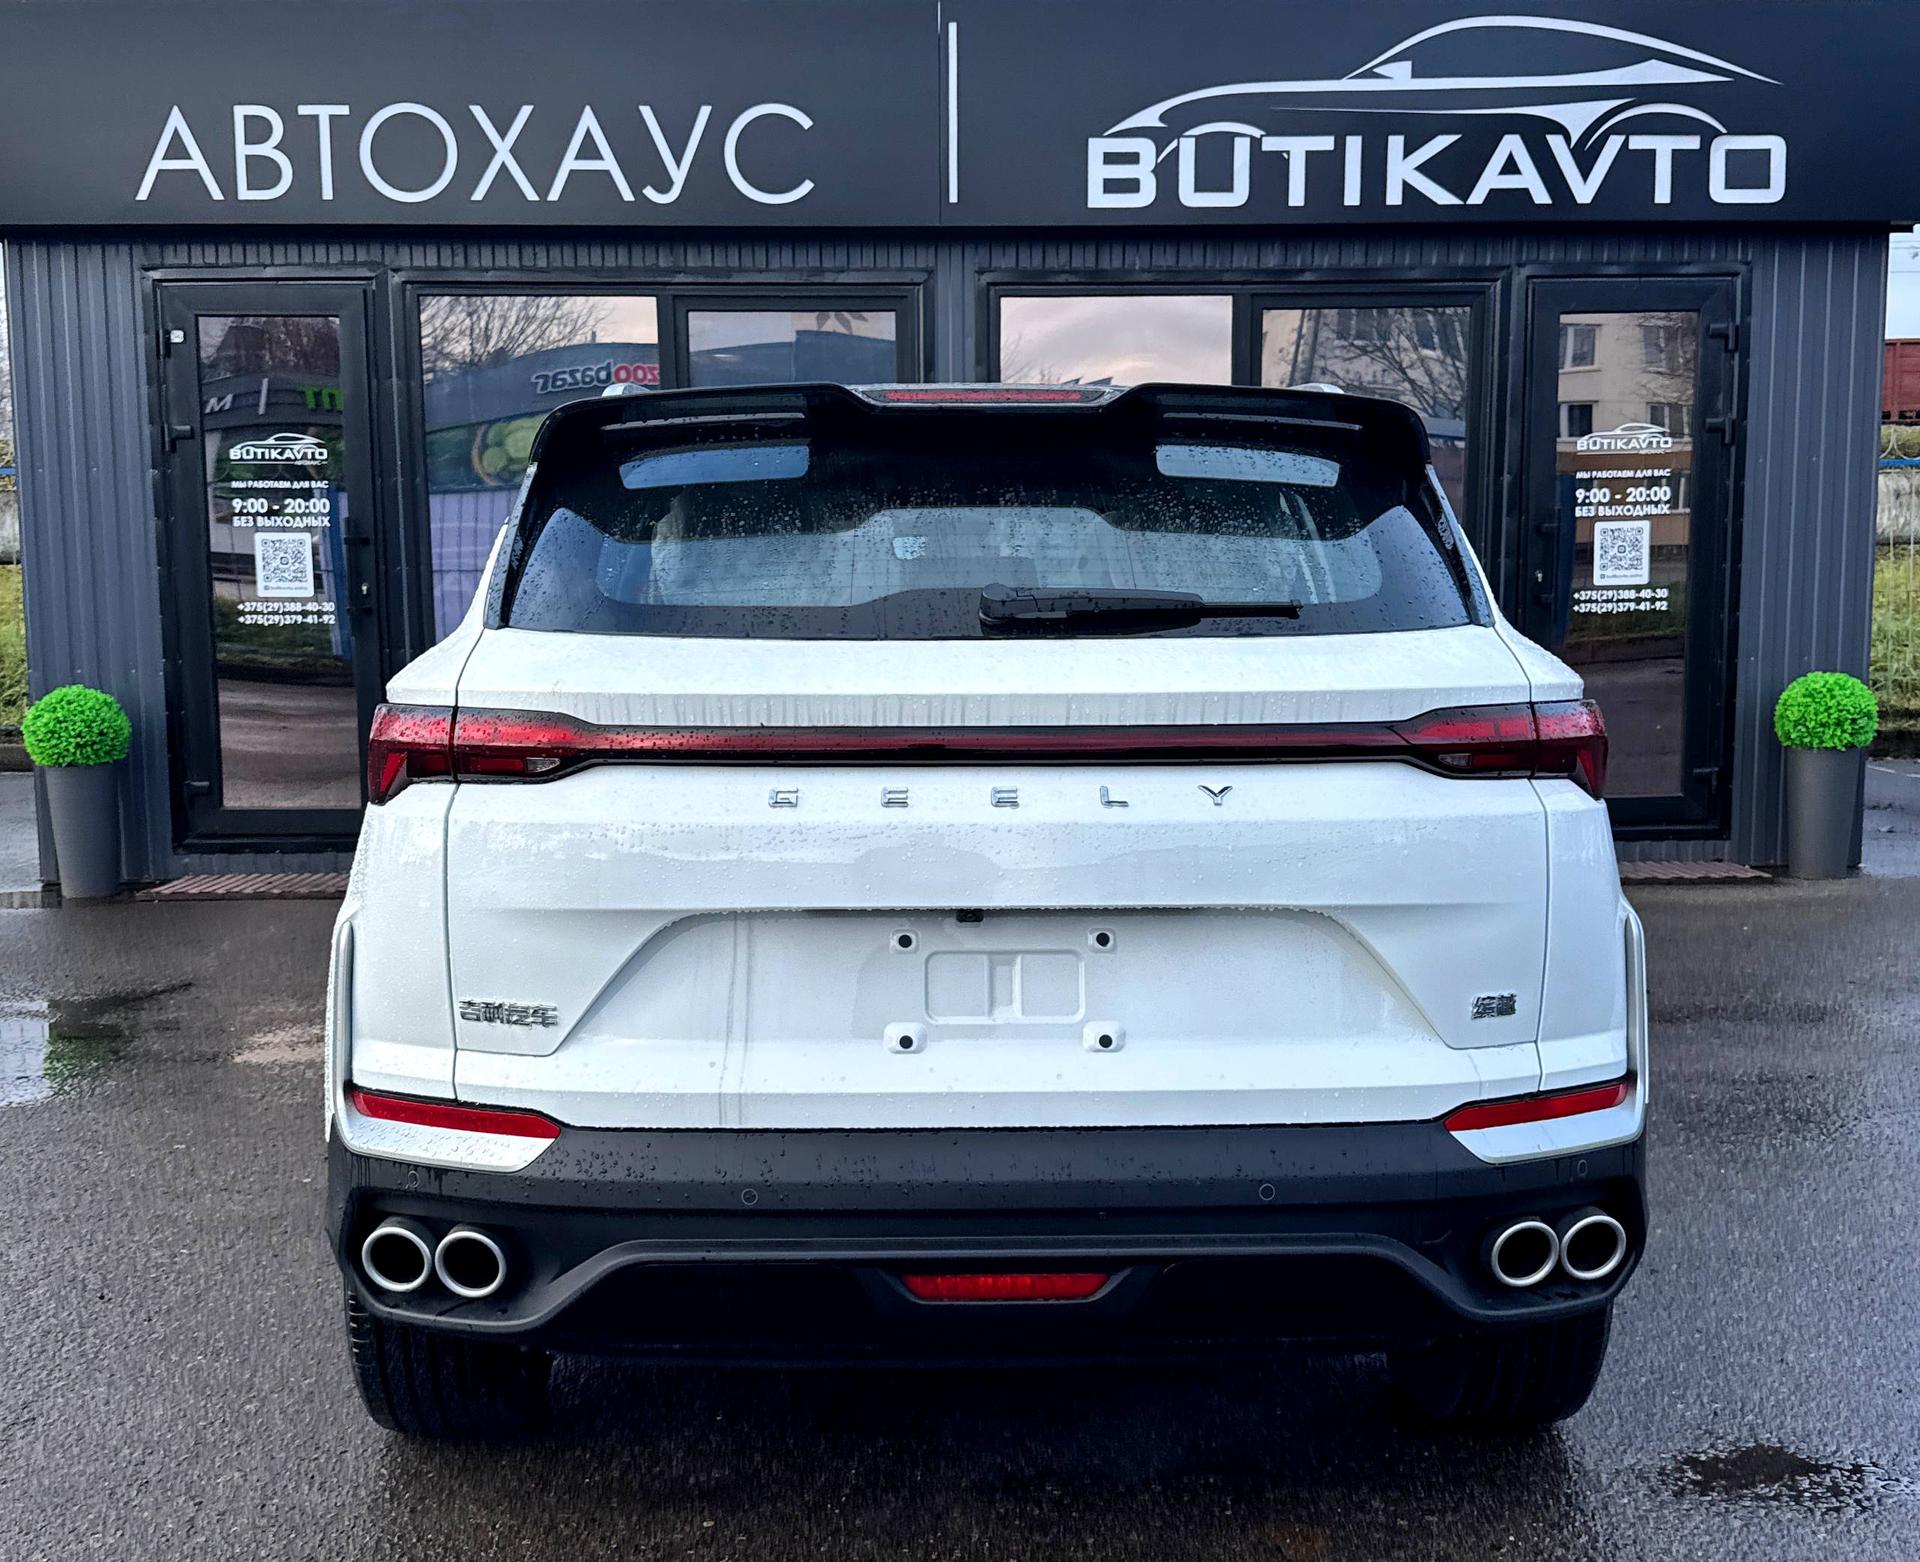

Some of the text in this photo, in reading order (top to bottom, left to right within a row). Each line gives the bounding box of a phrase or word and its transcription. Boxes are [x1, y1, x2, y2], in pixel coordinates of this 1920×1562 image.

[135, 102, 815, 205] АВТОХАУС
[1087, 135, 1787, 208] BUTIKAVTO
[1576, 437, 1672, 450] BUTIKAVTO
[229, 448, 328, 460] BUTIKAVTO
[1576, 468, 1671, 479] МЫ РАБОТАЕМ ДЛЯ ВАС
[248, 481, 291, 489] РАБОТАЕМ
[311, 481, 329, 489] ВАС
[1575, 487, 1611, 503] 9:00
[1625, 486, 1671, 502] 20:00
[232, 498, 268, 513] 9:00
[284, 498, 330, 513] 20:00
[1575, 504, 1671, 517] БЕЗ ВЫХОДНЫХ
[233, 516, 331, 528] БЕЗ ВЫХОДНЫХ
[1572, 601, 1669, 614] +375(29)379-41-92
[768, 785, 1234, 808] GEELY
